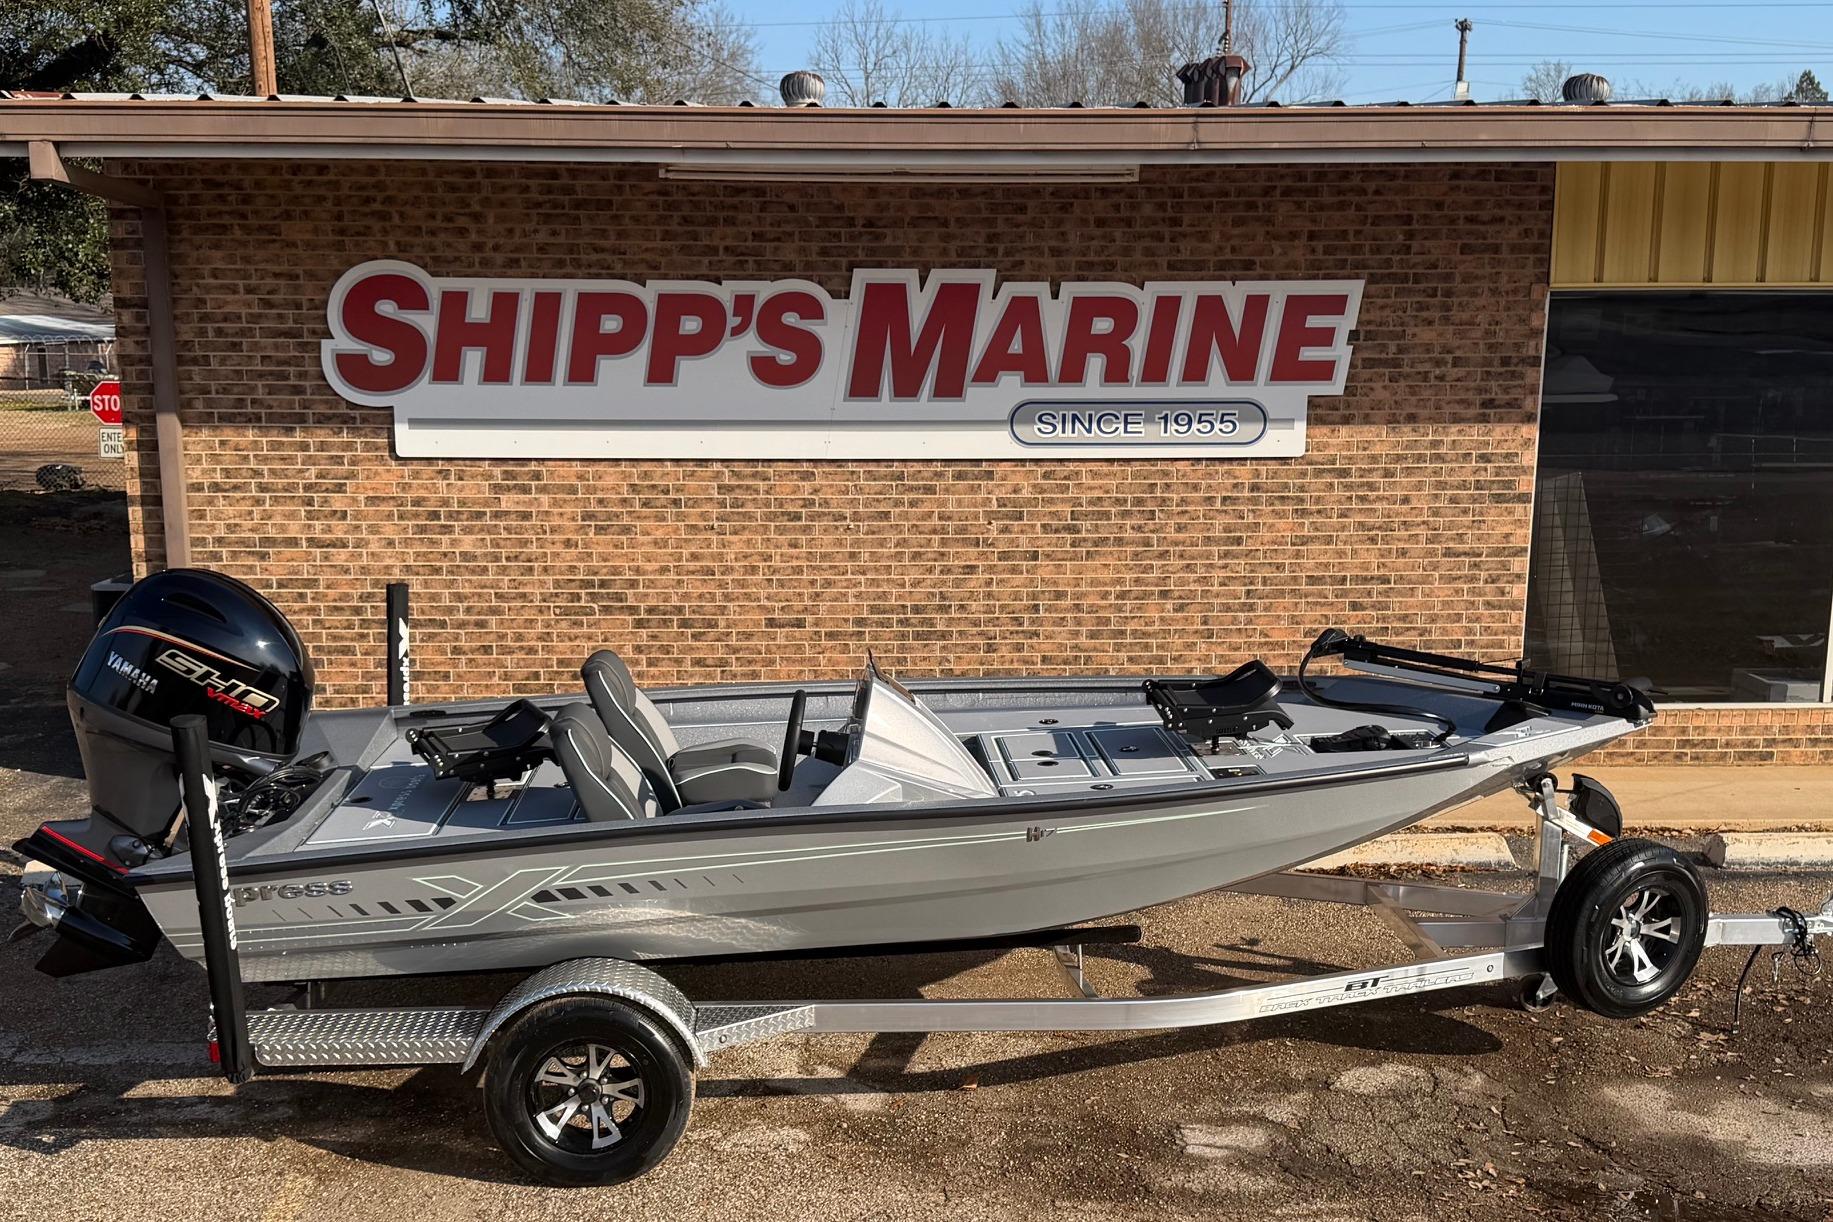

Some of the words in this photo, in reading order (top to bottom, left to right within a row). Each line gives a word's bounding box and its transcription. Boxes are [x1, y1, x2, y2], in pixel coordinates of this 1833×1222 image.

[332, 272, 827, 394] SHIPP'S
[846, 281, 1350, 400] MARINE
[93, 395, 120, 412] STO
[101, 432, 123, 442] ENTE
[1035, 411, 1145, 437] SINCE
[1156, 411, 1240, 437] 1955
[106, 650, 159, 695] YAMAHA
[155, 649, 280, 712] SHO
[233, 880, 353, 907] press
[1344, 975, 1389, 992] BT
[1383, 972, 1474, 994] TRAILERS
